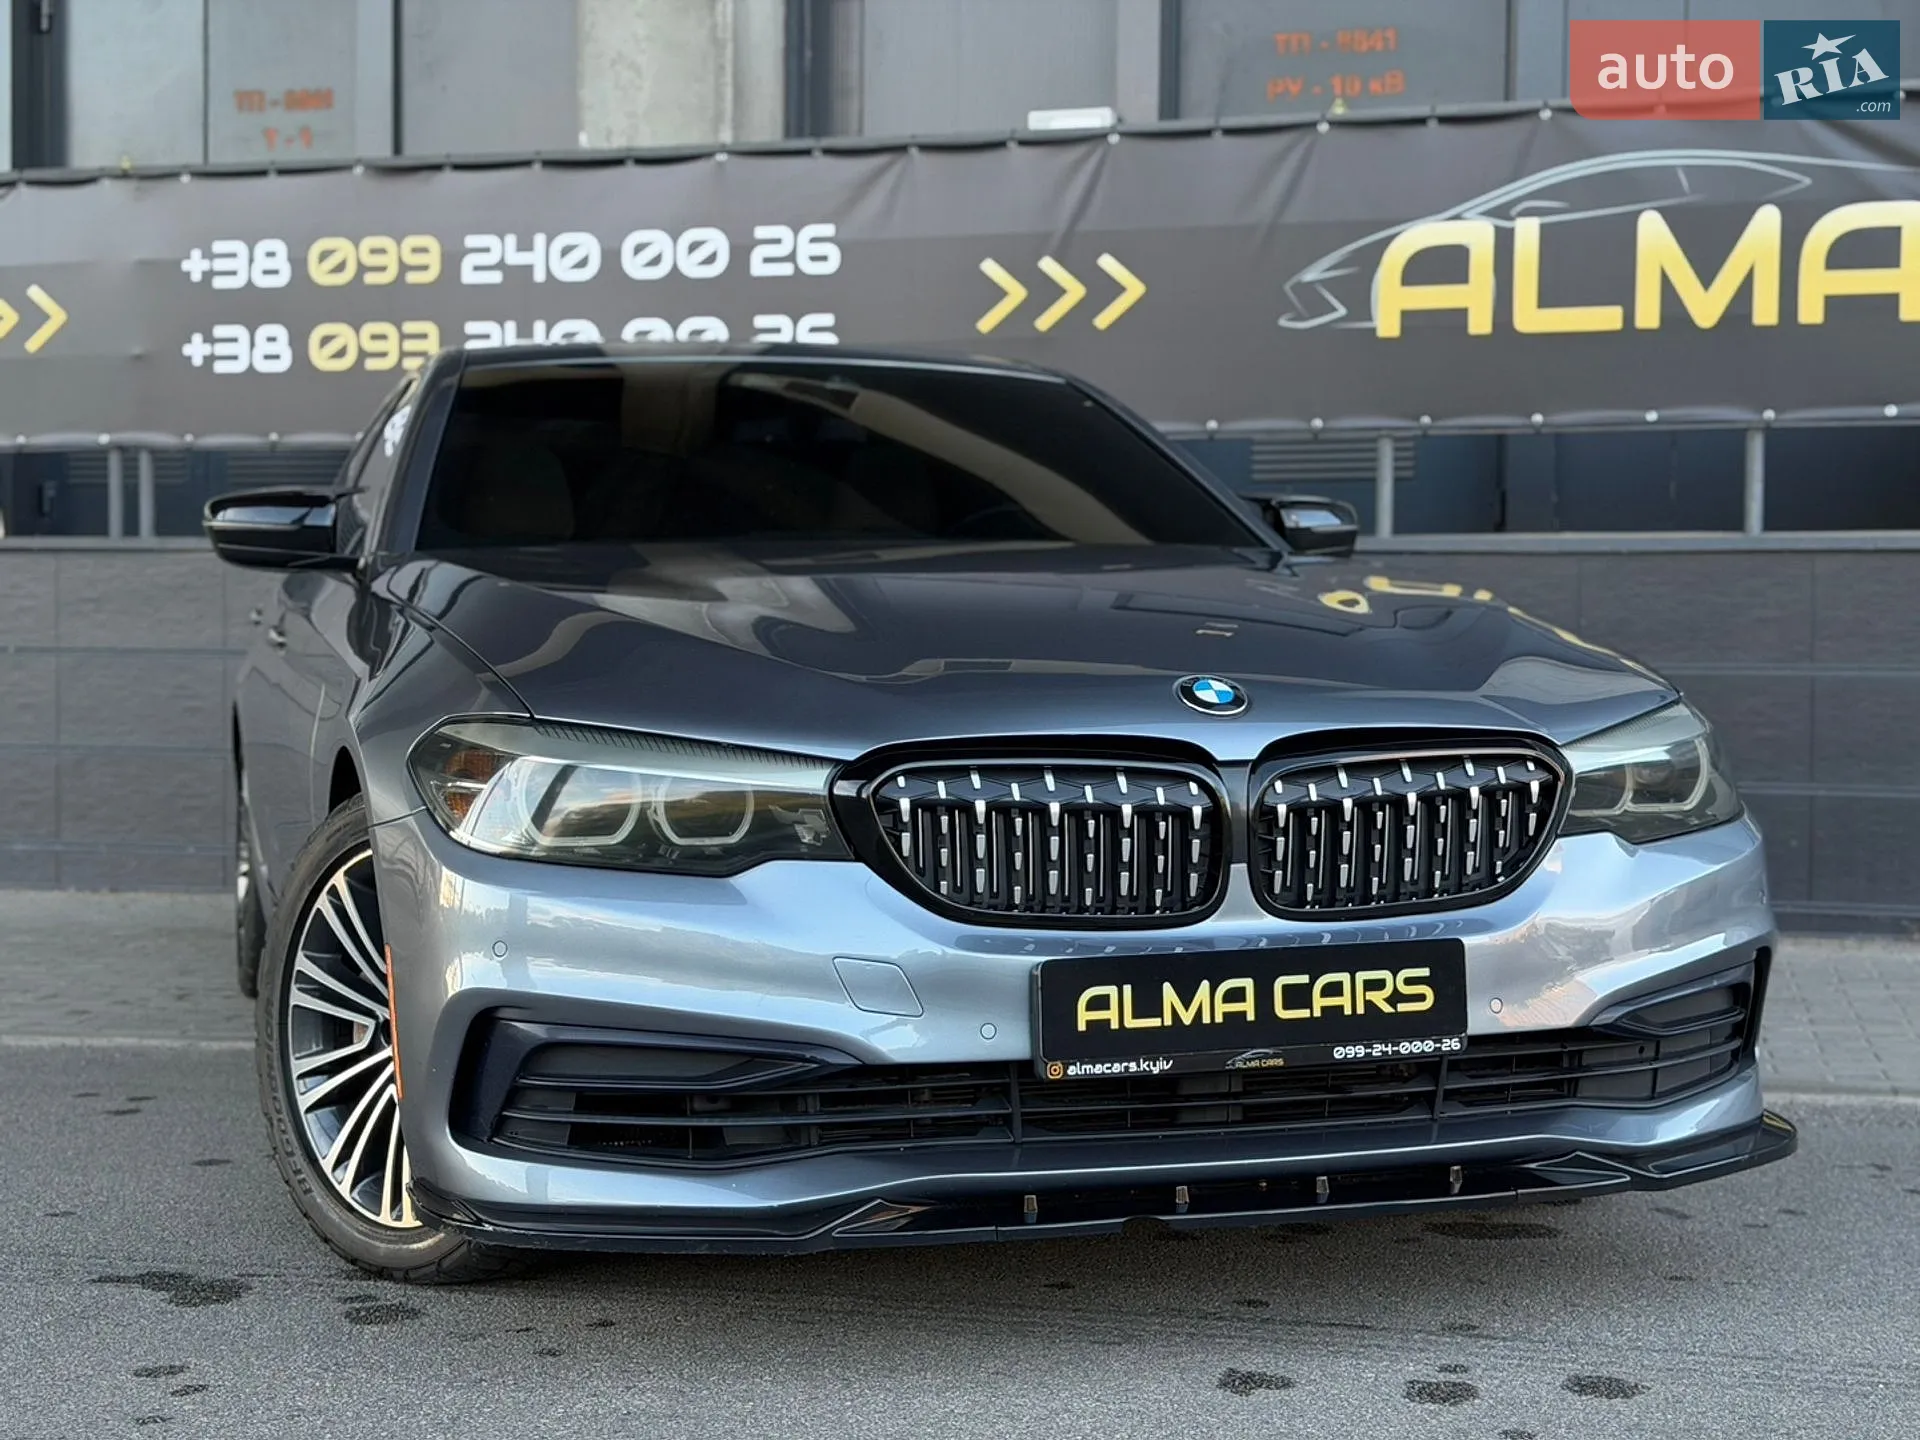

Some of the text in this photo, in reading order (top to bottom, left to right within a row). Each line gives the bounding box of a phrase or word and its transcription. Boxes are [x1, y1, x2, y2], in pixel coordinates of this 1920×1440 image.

[181, 223, 842, 289] +38 099 240 00 26
[1376, 200, 1920, 338] ALMA
[182, 323, 293, 374] +38
[307, 320, 440, 372] 093
[1077, 967, 1436, 1031] ALMA CARS
[1067, 1057, 1173, 1076] almacars.kyiv
[1333, 1037, 1461, 1059] 099-24-000-26
